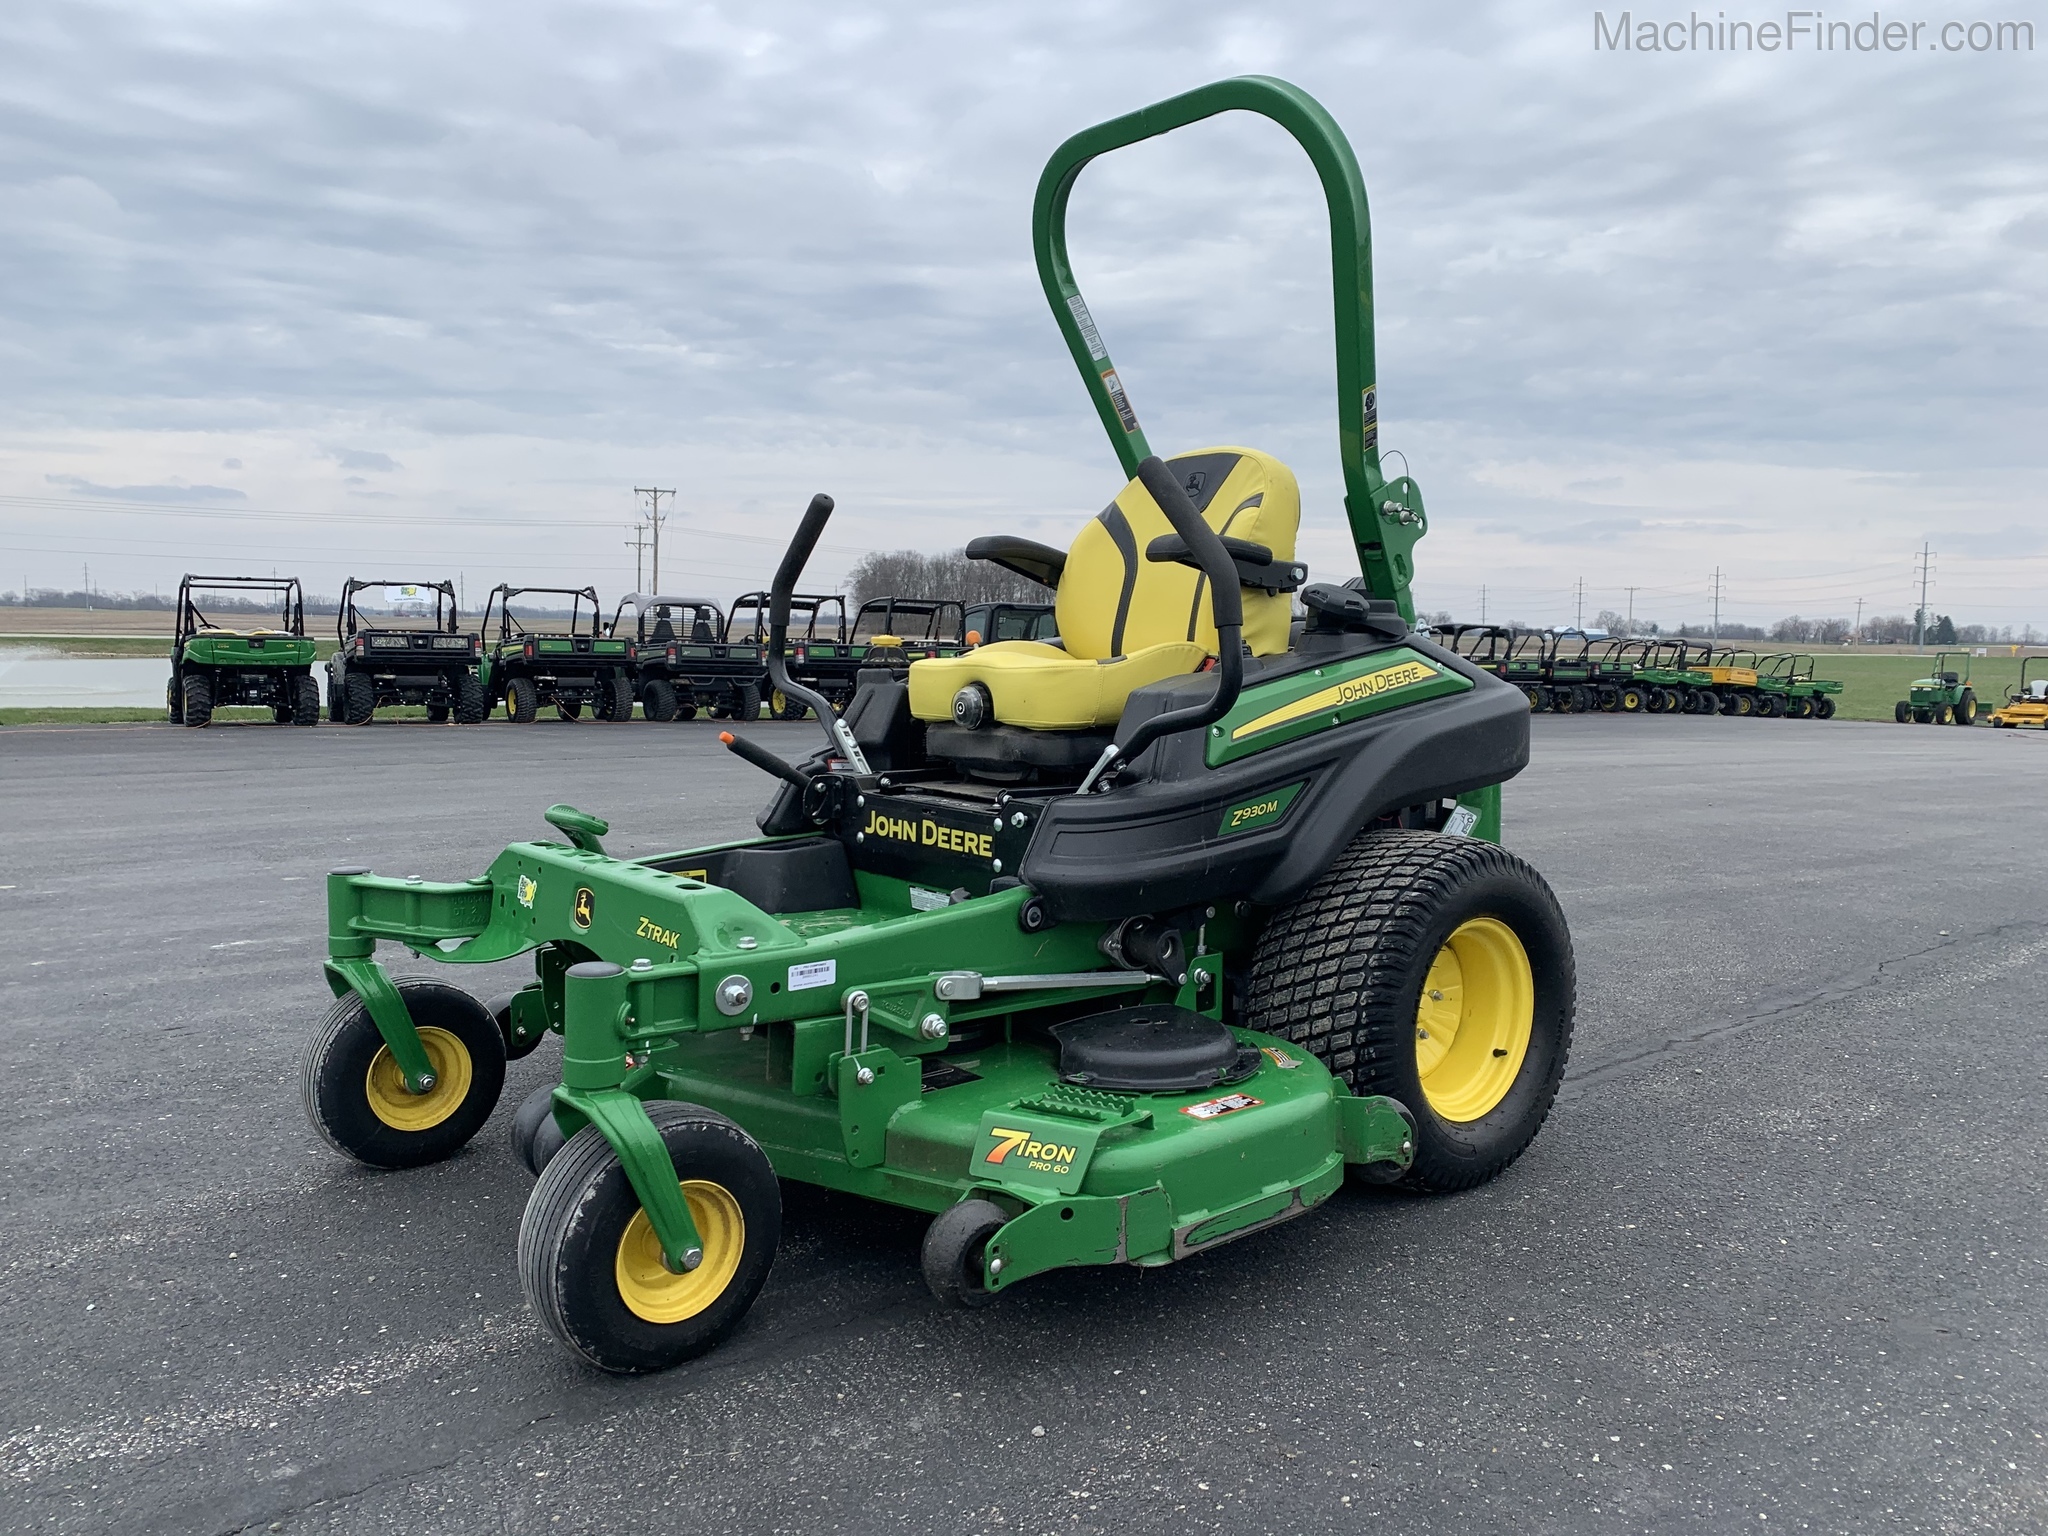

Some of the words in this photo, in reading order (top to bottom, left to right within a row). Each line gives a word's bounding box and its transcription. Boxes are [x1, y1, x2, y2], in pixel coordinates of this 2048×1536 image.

[1336, 680, 1374, 704] JOHN
[1375, 667, 1421, 690] DEERE
[1230, 800, 1278, 827] Z930M
[865, 810, 917, 843] JOHN
[922, 819, 993, 858] DEERE
[636, 916, 681, 949] ZTRAK
[1028, 1160, 1052, 1172] PRO
[1053, 1164, 1069, 1174] 60
